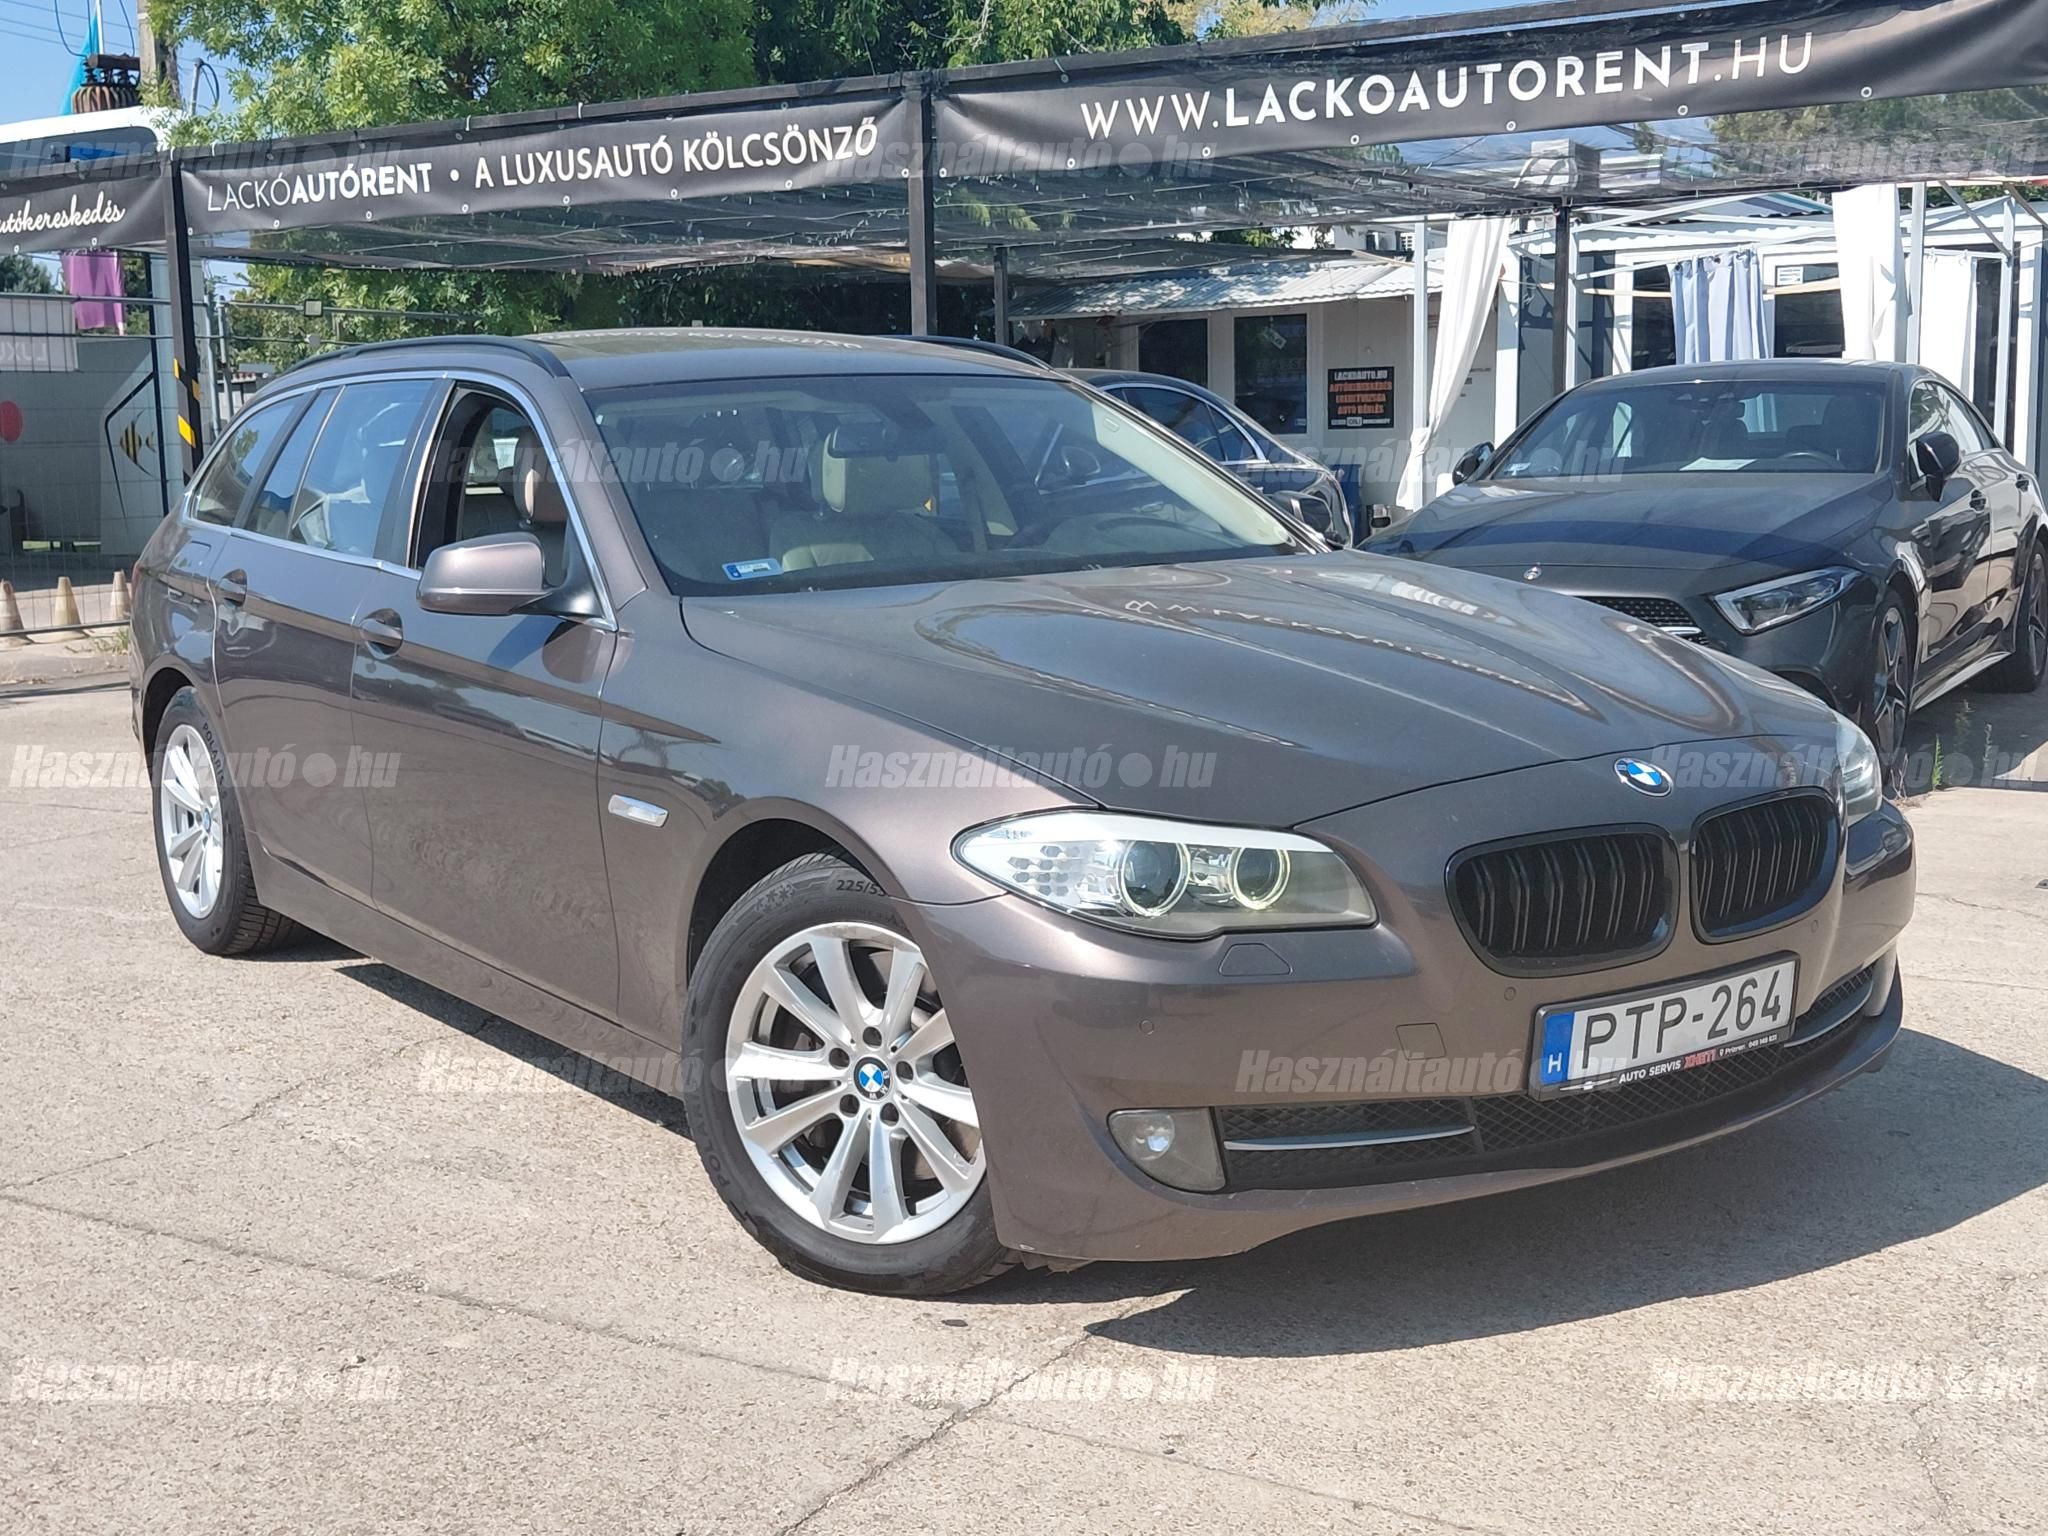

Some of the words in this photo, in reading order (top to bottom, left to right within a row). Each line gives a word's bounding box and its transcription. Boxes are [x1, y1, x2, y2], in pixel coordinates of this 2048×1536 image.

[1080, 32, 1813, 140] WWW.LACKOAUTORENT.HU
[207, 162, 433, 212] LACKÓAUTÓRENT
[474, 157, 495, 188] A
[500, 135, 674, 187] LUXUSAUTÓ
[683, 116, 878, 173] KÖLCSÖNZŐ
[0, 190, 126, 233] utókereskedés
[1581, 969, 1781, 1070] PTP-264
[1547, 1052, 1563, 1074] H
[1618, 1069, 1646, 1084] AUTO
[1649, 1059, 1681, 1077] SERVIS
